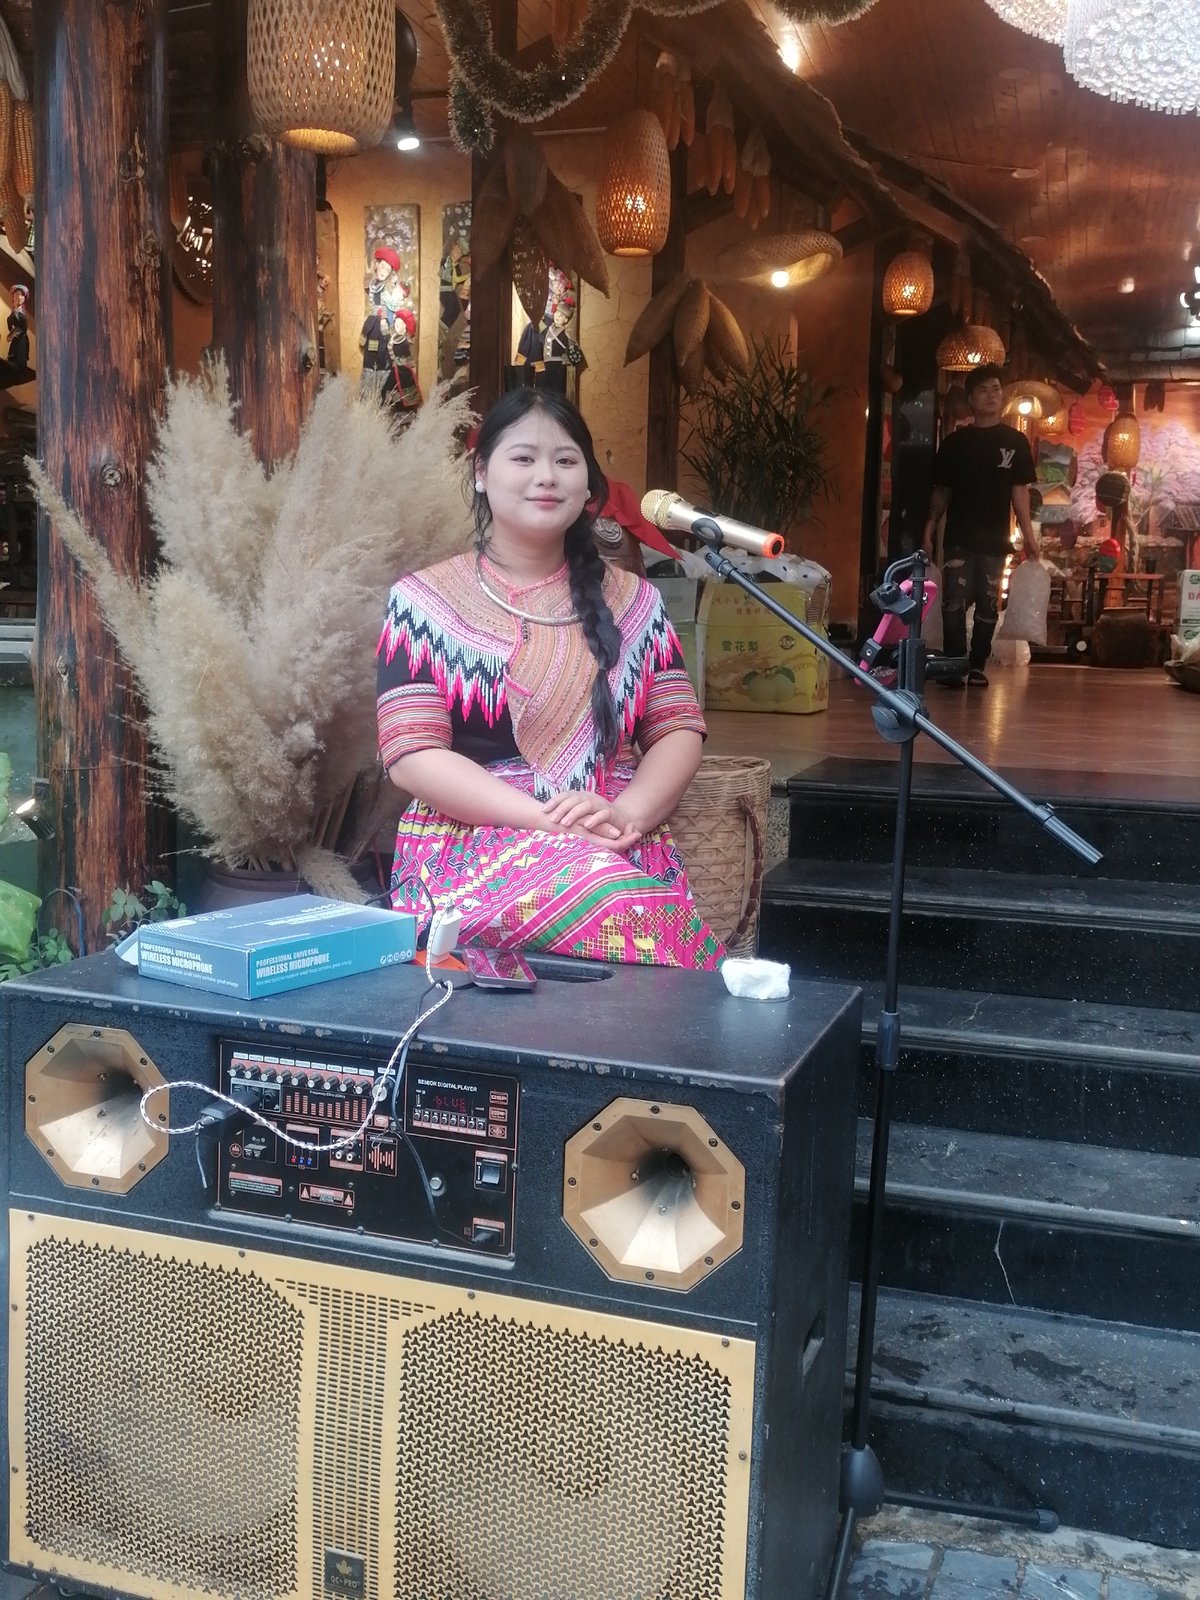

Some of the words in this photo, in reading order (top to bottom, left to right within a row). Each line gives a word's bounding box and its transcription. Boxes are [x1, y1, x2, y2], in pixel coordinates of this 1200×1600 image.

[722, 640, 758, 652] 雪花梨
[140, 942, 174, 955] PROFESSIONAL
[175, 950, 202, 961] UNIVERSAL
[256, 954, 292, 968] PROFESSIONAL
[293, 948, 319, 960] UNIVERSAL
[141, 950, 172, 966] WIRELESS
[172, 957, 213, 974] MICROPHONE
[256, 962, 288, 979] WIRELESS
[289, 953, 330, 971] MICROPHONE
